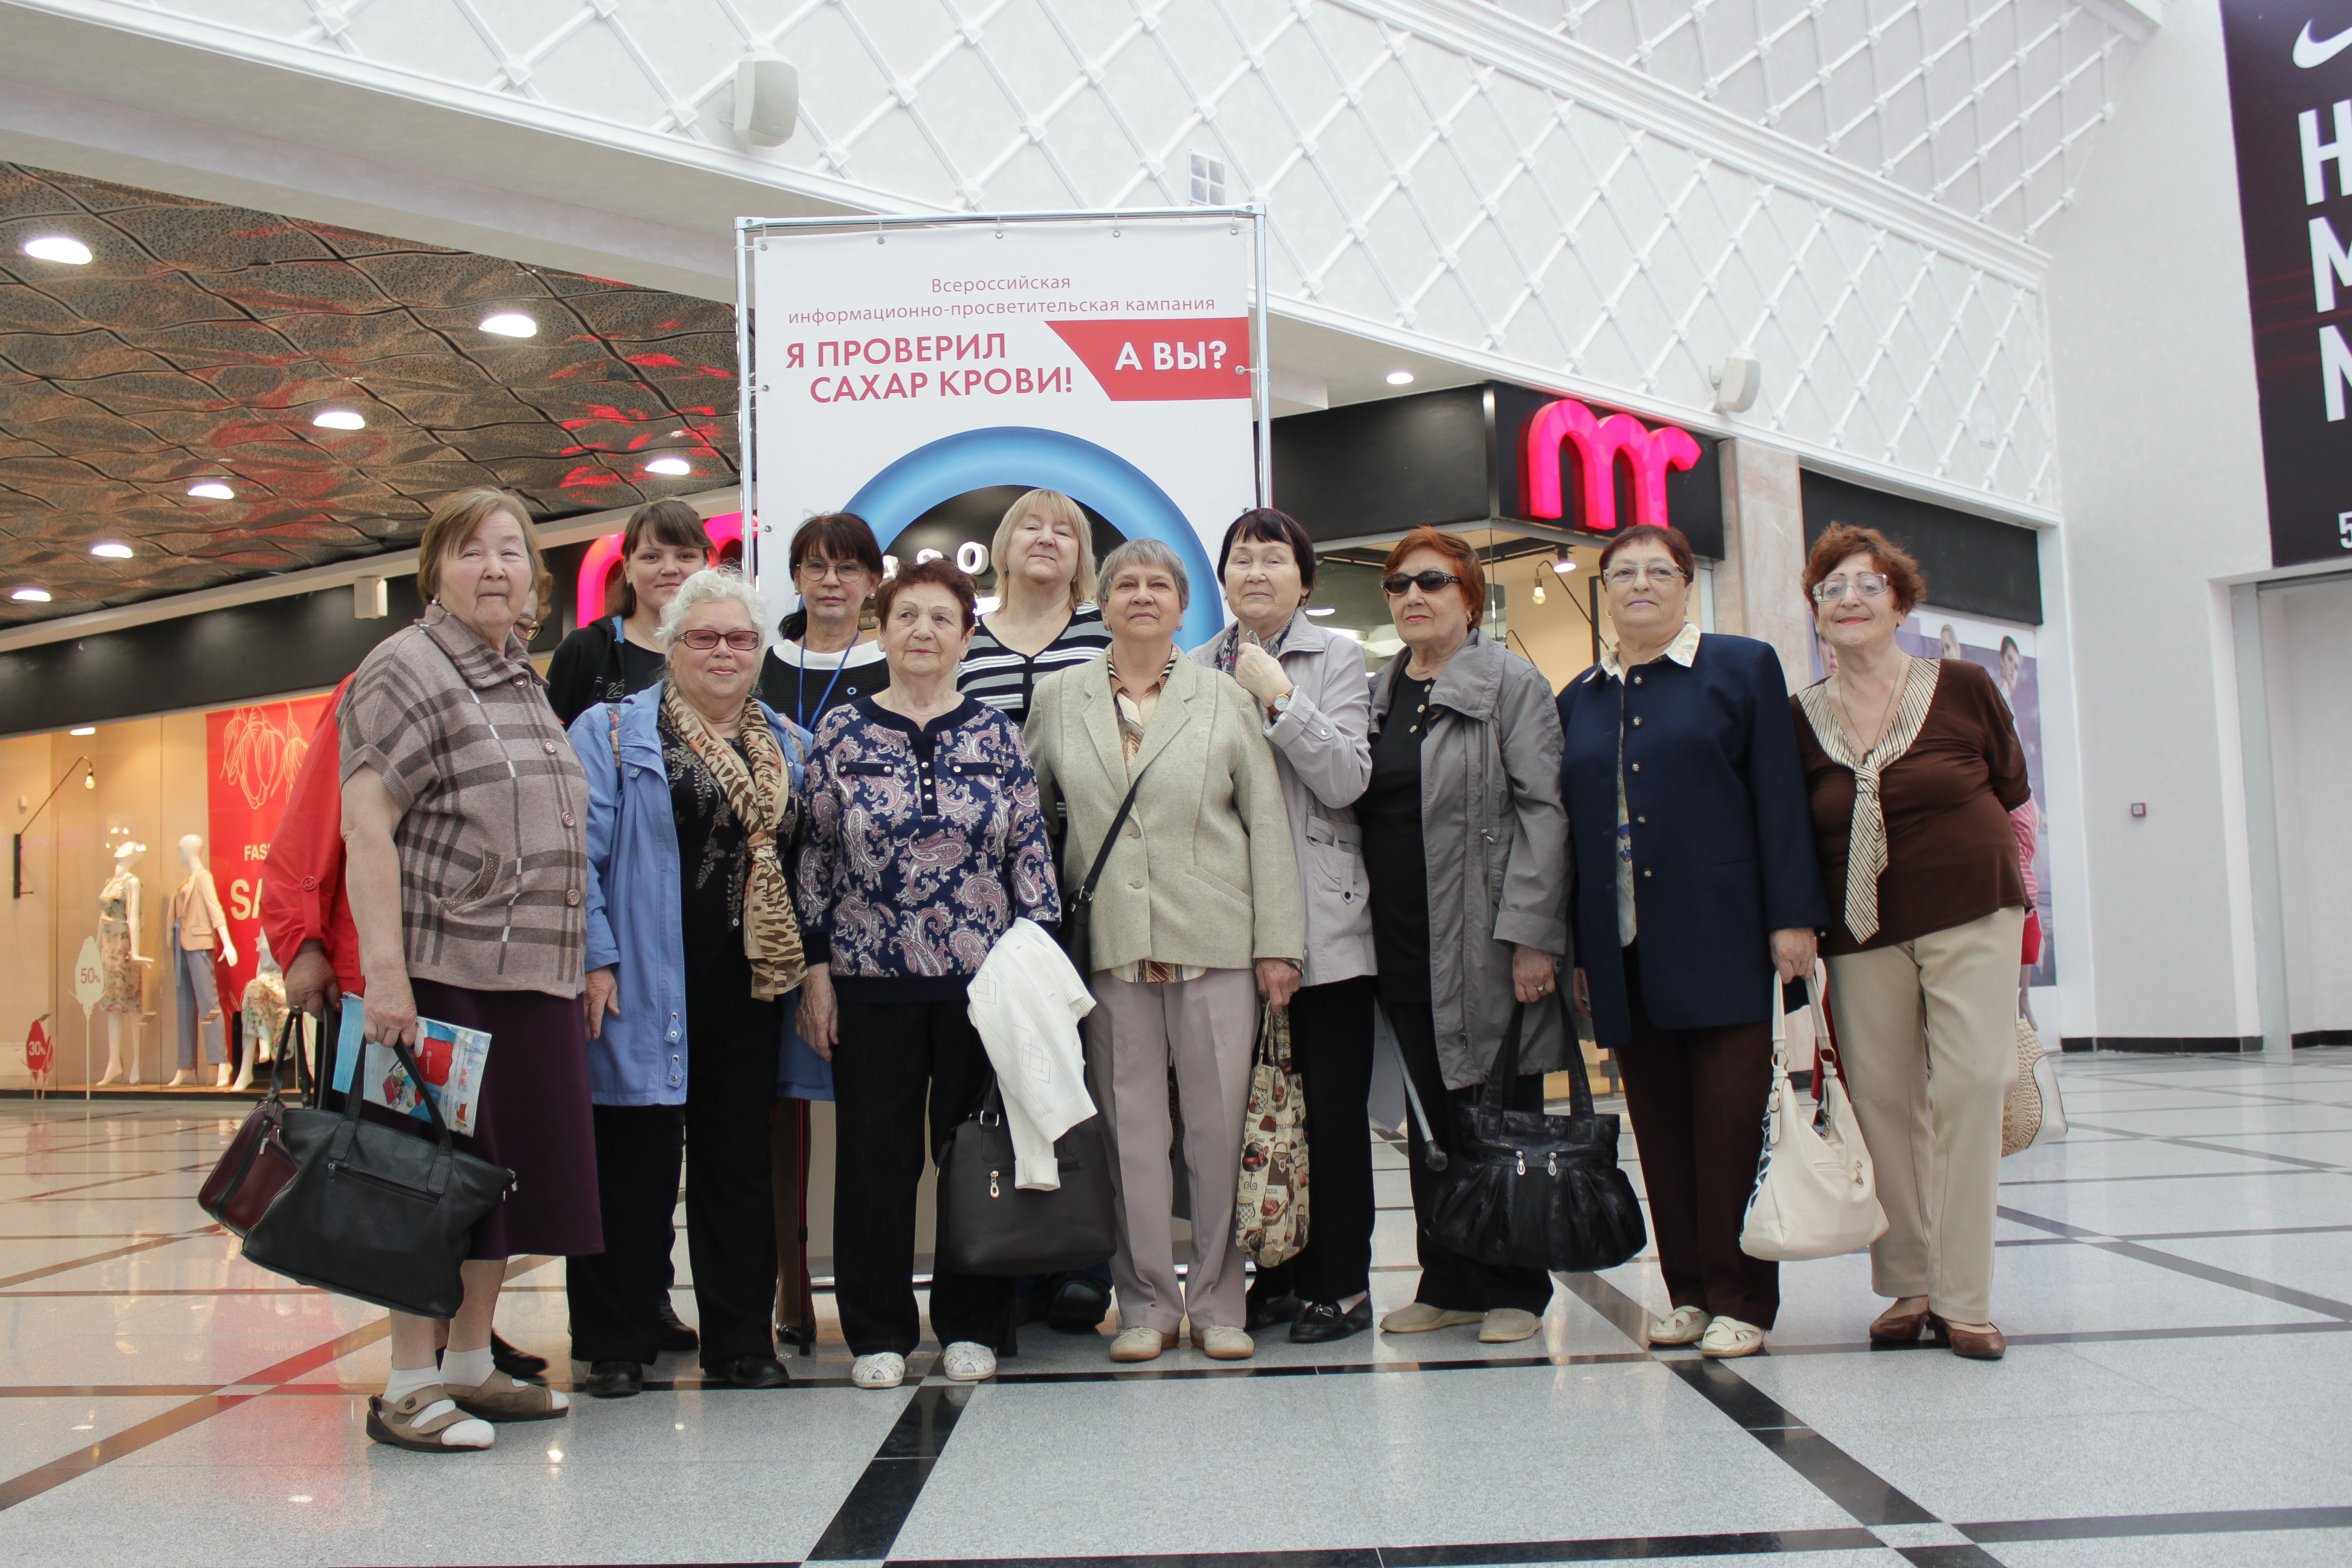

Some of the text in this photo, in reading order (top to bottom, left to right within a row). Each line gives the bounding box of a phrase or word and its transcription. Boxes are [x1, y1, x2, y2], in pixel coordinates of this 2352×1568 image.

[931, 275, 1071, 295] Всероссийская
[788, 299, 1216, 326] информационно-просветительская кампания
[786, 333, 1005, 368] Я ПРОВЕРИЛ
[1114, 340, 1227, 371] А ВЫ?
[811, 367, 1072, 403] САХАР КРОВИ!
[244, 843, 271, 861] FAS
[81, 968, 101, 984] 50%
[29, 1041, 47, 1056] 30%
